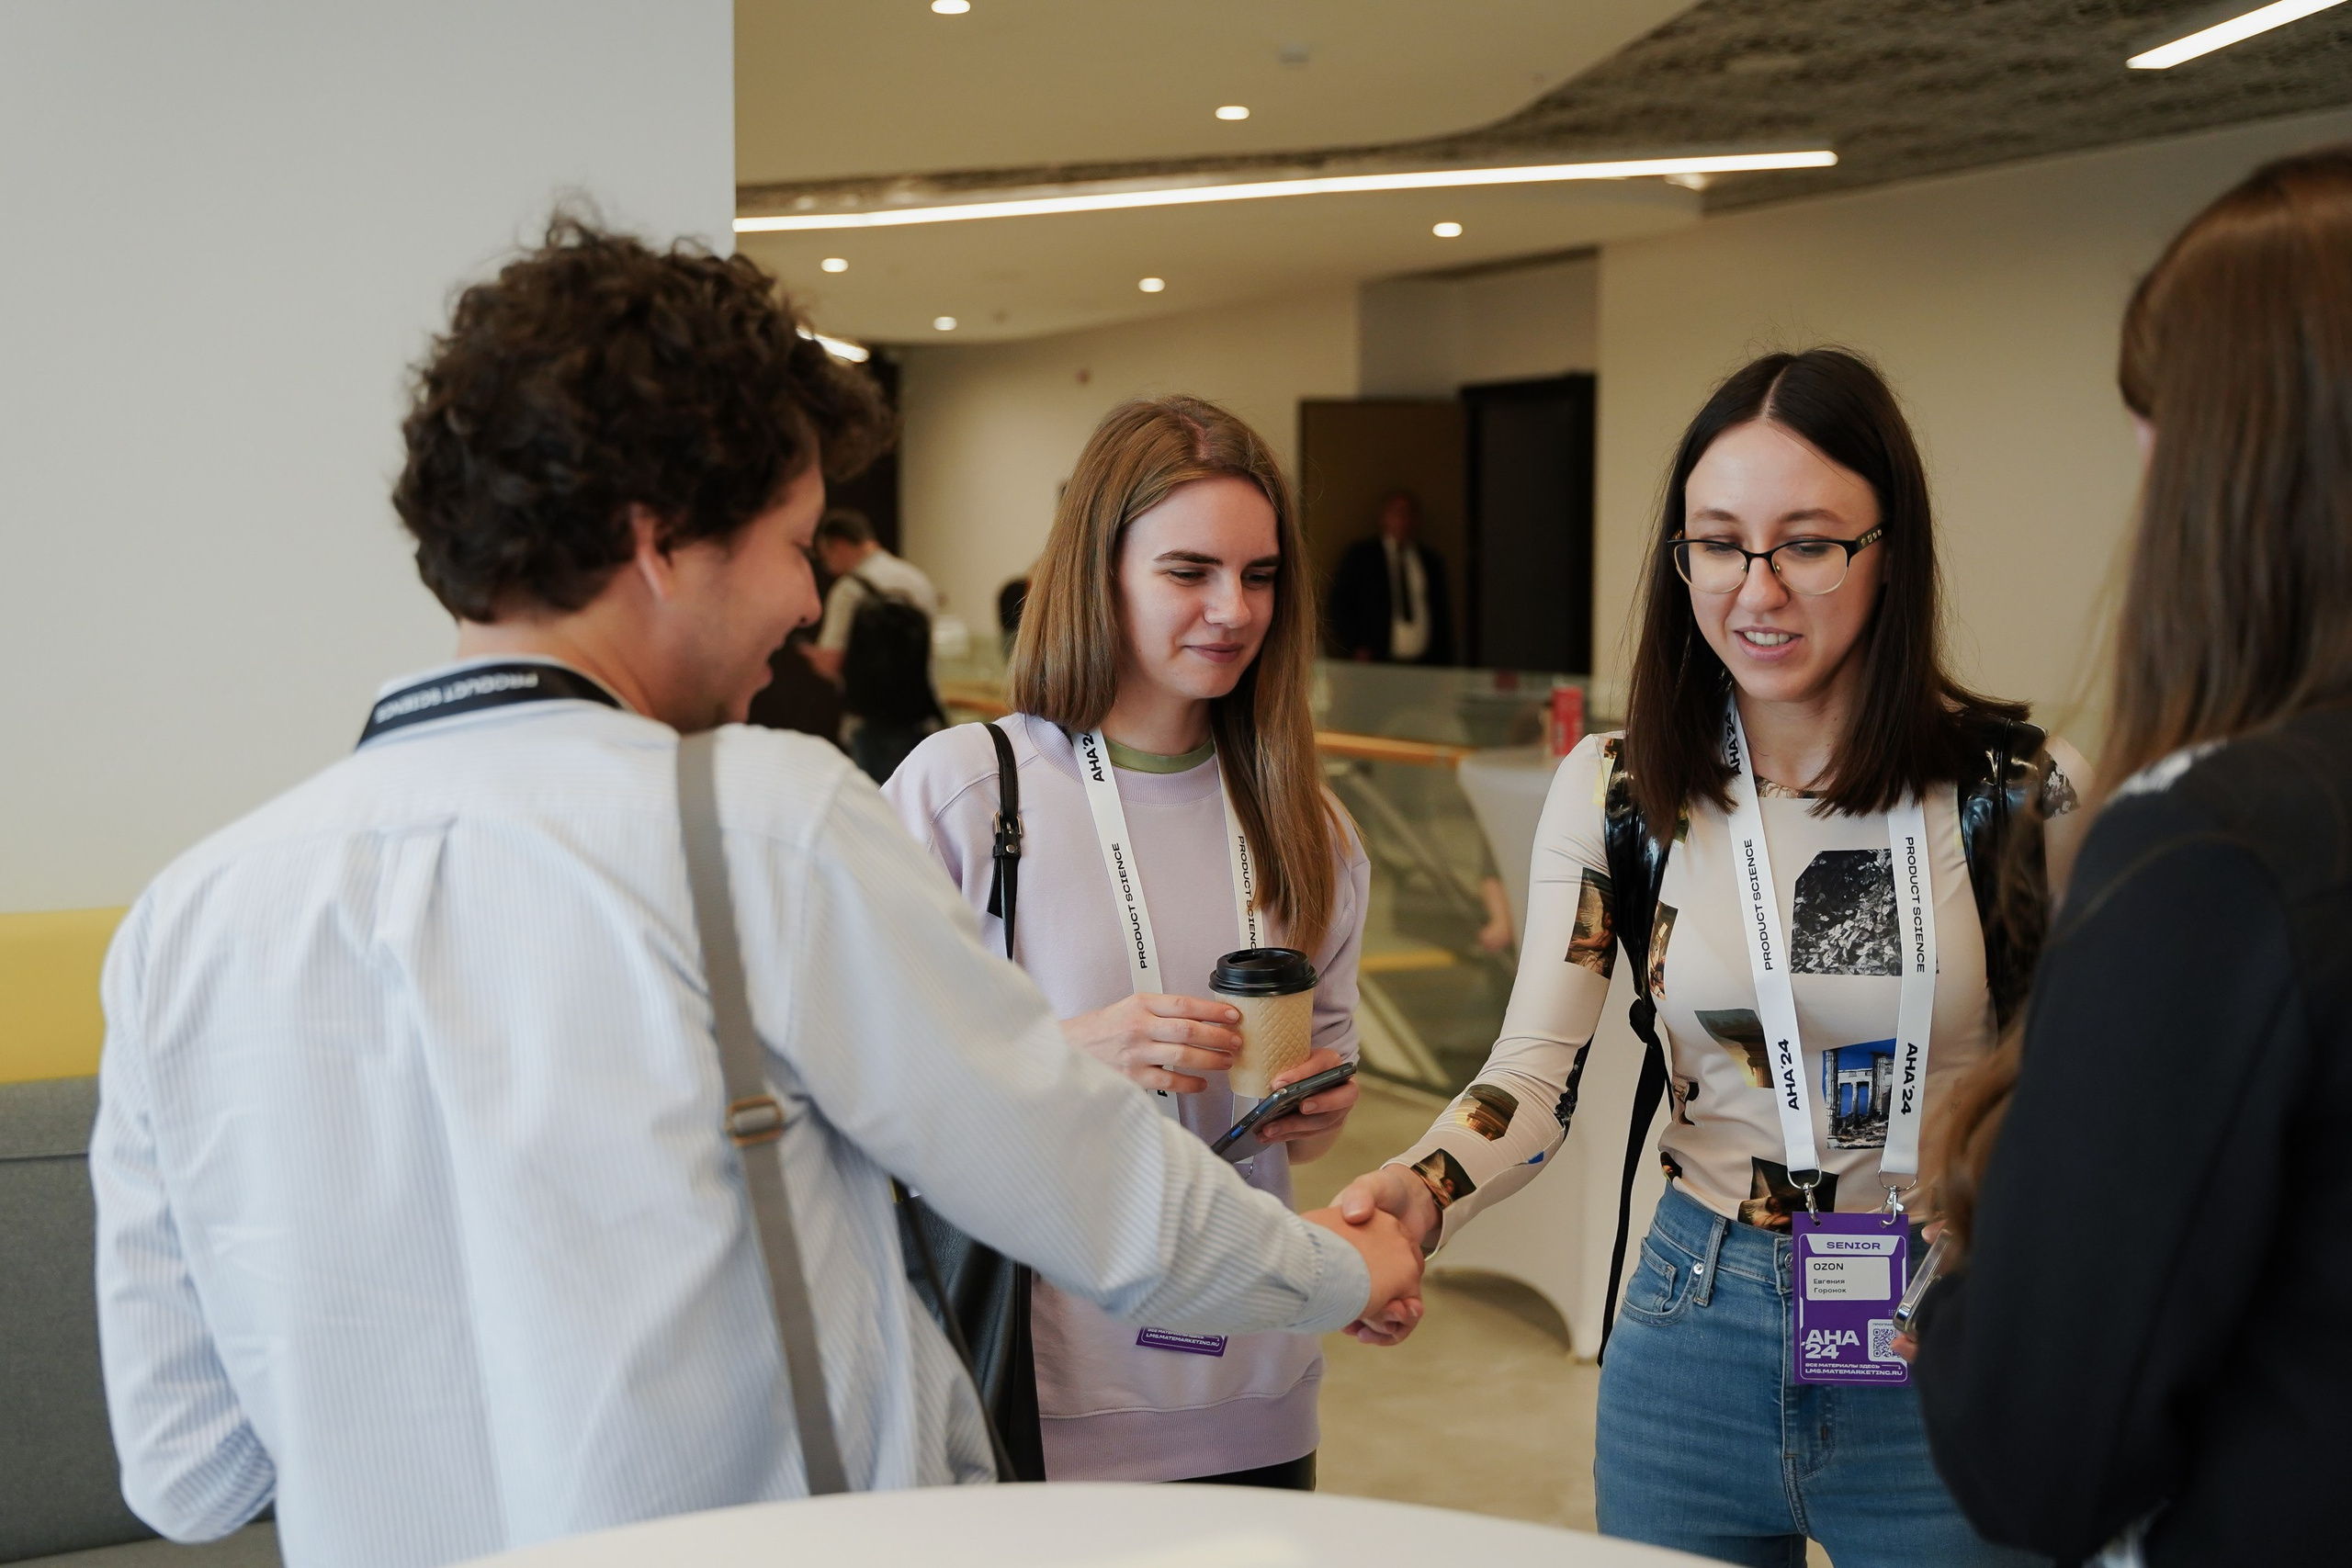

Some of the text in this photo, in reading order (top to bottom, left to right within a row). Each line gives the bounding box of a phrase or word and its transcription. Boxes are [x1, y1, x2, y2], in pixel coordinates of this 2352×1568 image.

[1082, 732, 1105, 782] AHA'2
[1238, 835, 1252, 898] PRODUCT
[1112, 842, 1148, 969] PRODUCT SCIENCE
[1744, 839, 1773, 970] PRODUCT SCIENCE
[1905, 836, 1925, 973] PRODUCT SCIENCE
[1778, 1039, 1800, 1111] AHA'24
[1901, 1043, 1917, 1115] AHA'24
[1813, 1262, 1844, 1271] OZON
[1826, 1241, 1881, 1250] SENIOR
[1804, 1368, 1903, 1376] LMS.MATEMARKETING.RU
